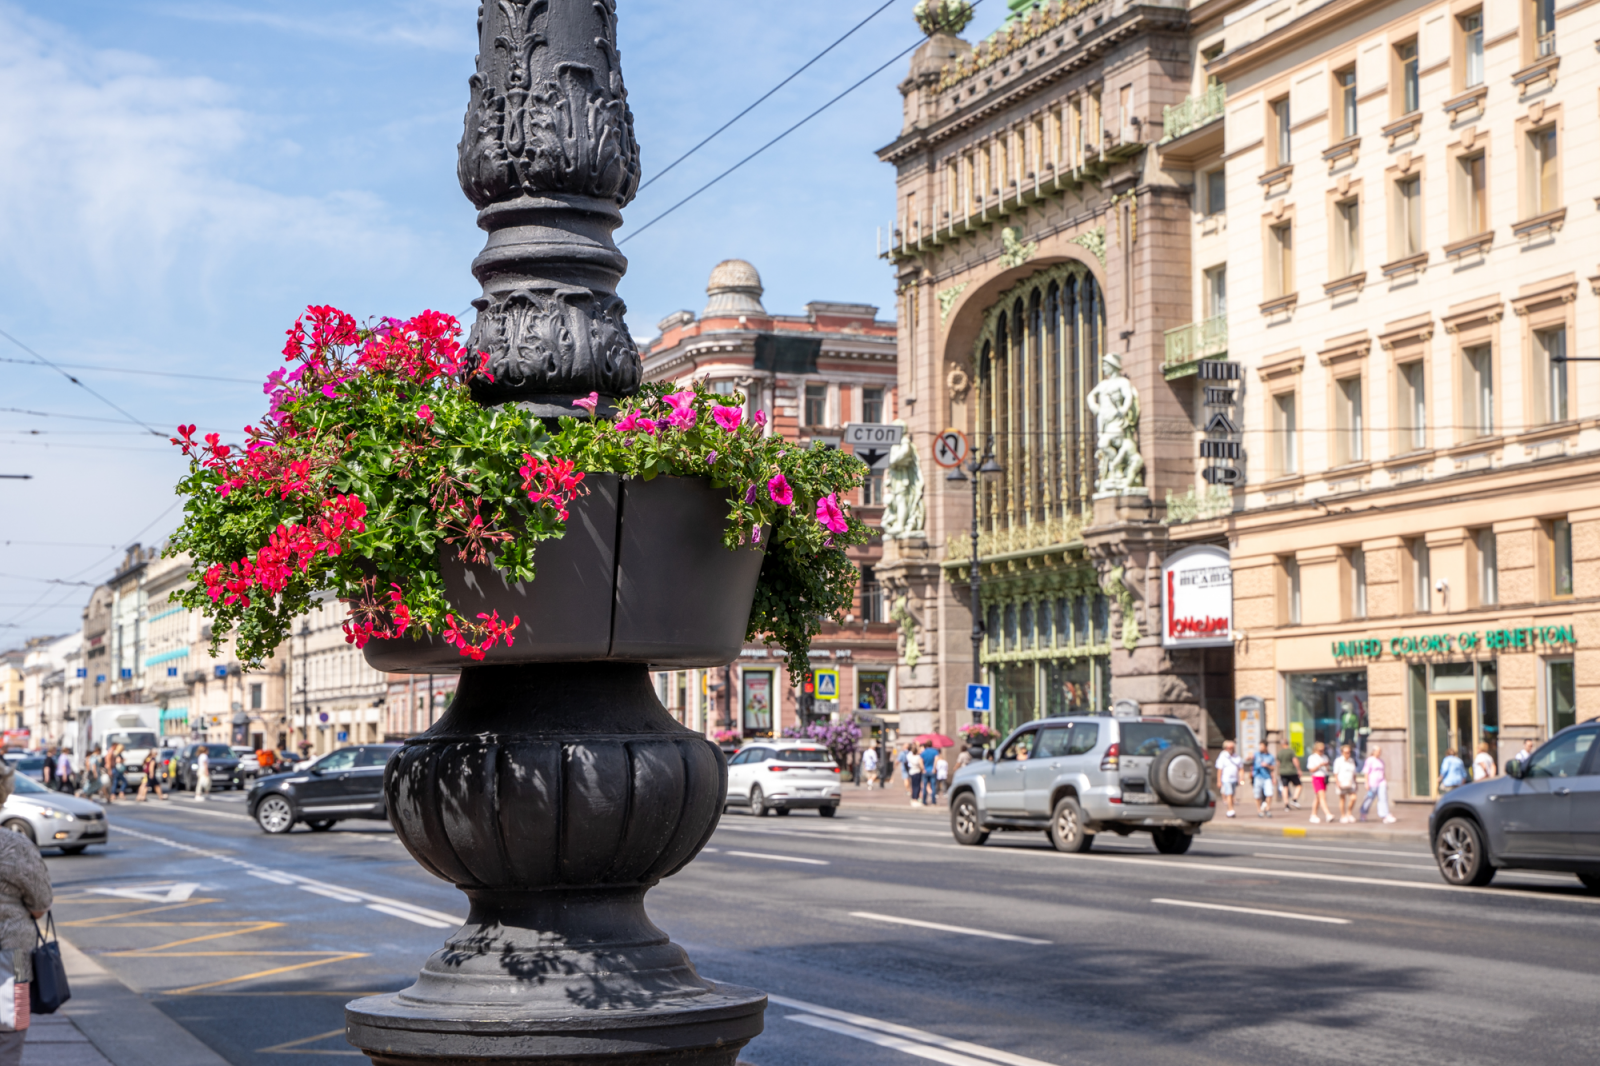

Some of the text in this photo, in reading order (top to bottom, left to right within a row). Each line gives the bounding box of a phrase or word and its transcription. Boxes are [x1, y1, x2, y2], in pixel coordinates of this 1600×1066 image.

[854, 428, 895, 441] СТОП
[1331, 638, 1381, 658] UNITED
[1390, 633, 1450, 655] COLORS
[1458, 631, 1478, 651] OF
